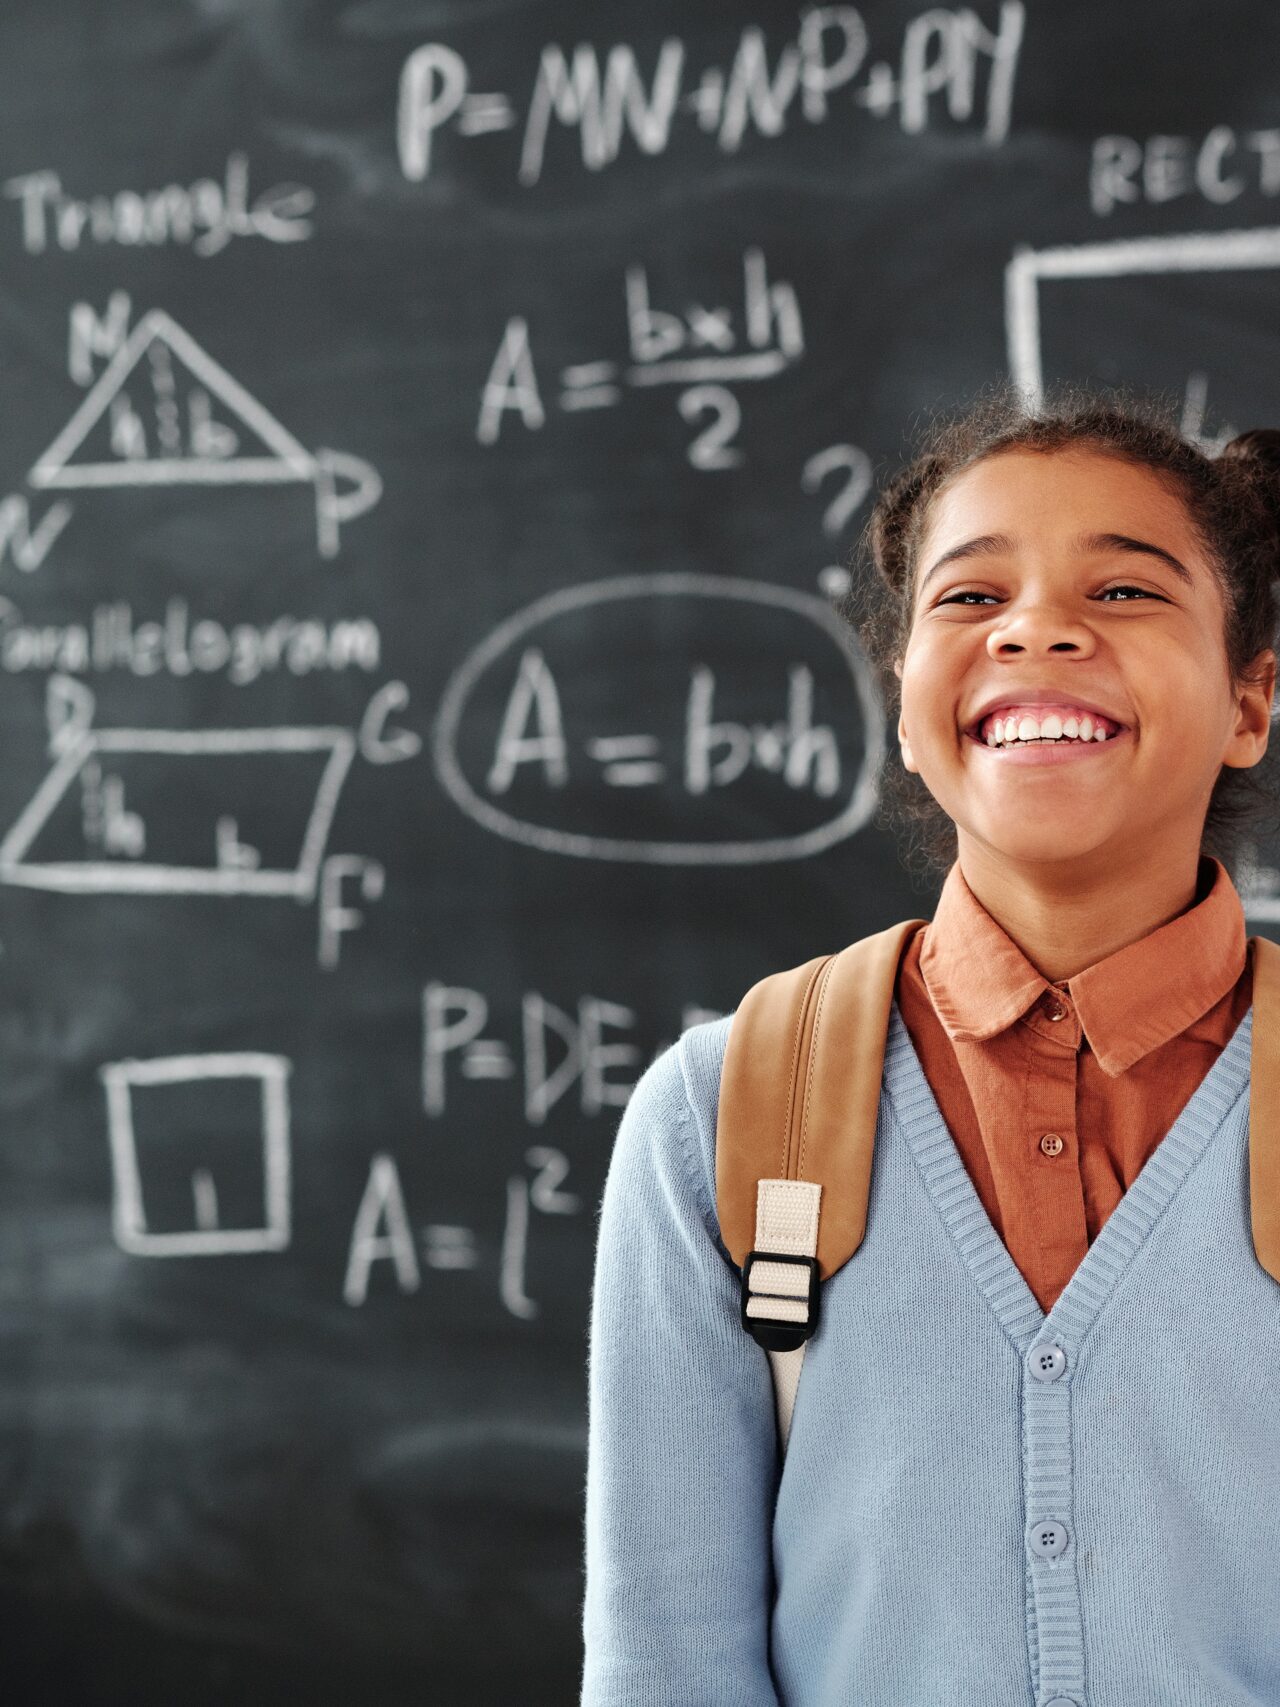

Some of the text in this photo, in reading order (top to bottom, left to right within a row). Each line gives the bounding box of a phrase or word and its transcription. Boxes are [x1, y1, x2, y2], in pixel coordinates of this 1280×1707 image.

[2, 150, 316, 256] Triangle
[476, 315, 546, 446] A
[678, 386, 742, 471] 2
[314, 445, 383, 558] P
[487, 645, 568, 797] A
[317, 853, 386, 972] F
[342, 1150, 420, 1308] A
